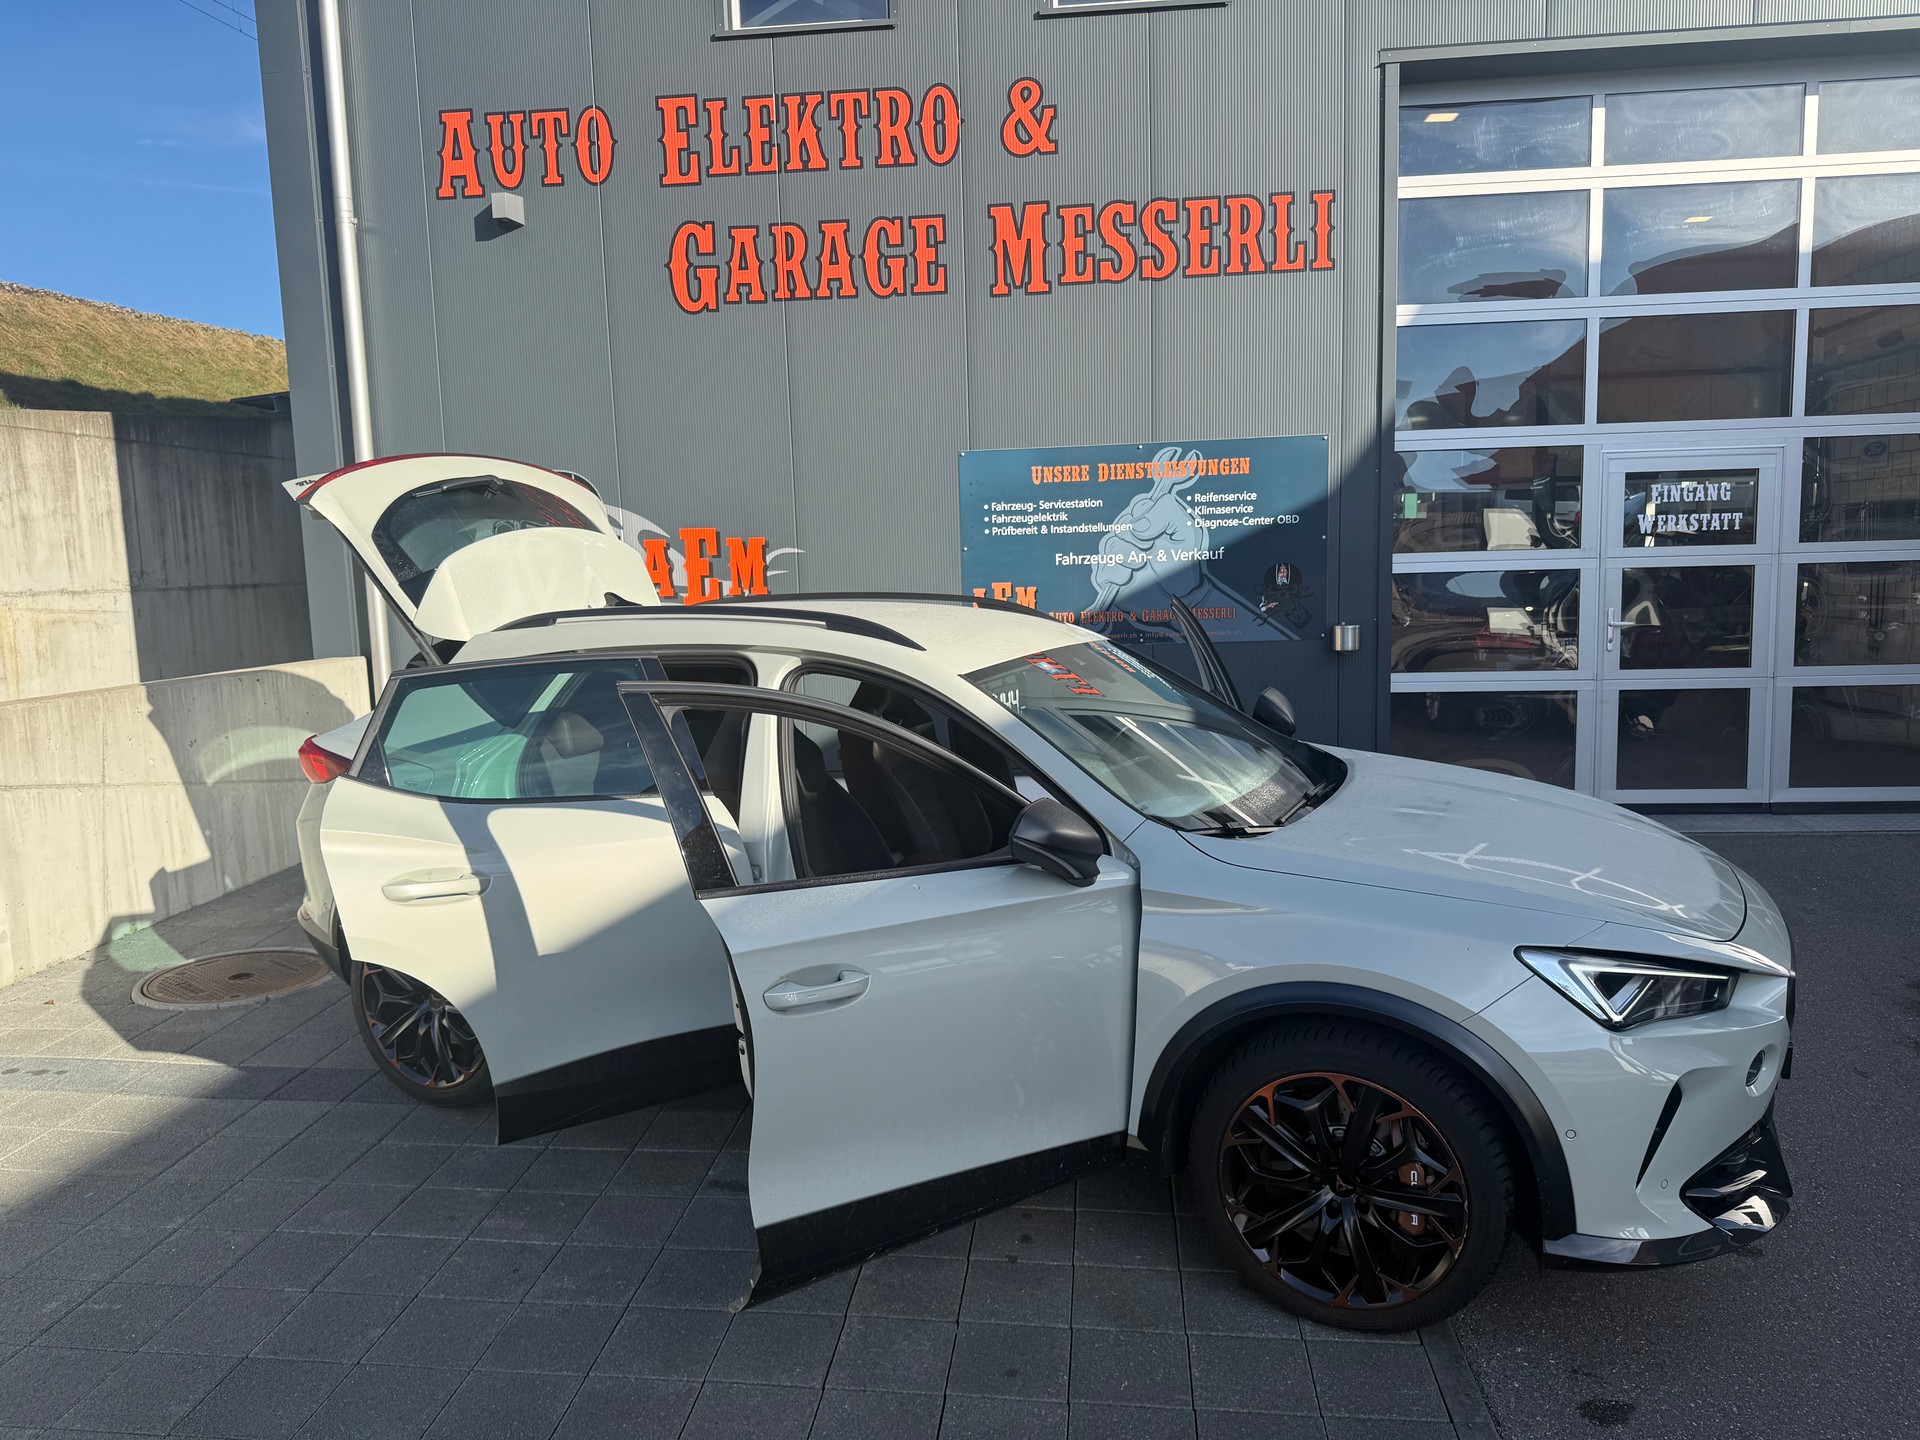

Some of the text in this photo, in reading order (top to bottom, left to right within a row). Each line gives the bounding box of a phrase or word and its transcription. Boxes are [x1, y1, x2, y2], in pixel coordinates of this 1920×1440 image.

[437, 77, 1057, 200] AUTO ELEKTRO &
[667, 191, 1335, 314] GARAGE MESSERLI
[1031, 465, 1090, 485] UNSERE
[1194, 491, 1258, 503] Reifenservice
[1651, 481, 1731, 504] EINGANG
[991, 498, 1103, 513] Fahrzeug- Servicestation
[1194, 503, 1254, 516] Klimaservice
[991, 511, 1068, 524] Fahrzeugelektrik
[1195, 514, 1300, 529] Diagnose-Center OBD
[1637, 512, 1743, 535] WERKSTATT
[992, 521, 1133, 536] Prüfbereit & Instandstellungen
[1054, 546, 1225, 567] Fahrzeuge An- & Verkauf
[1081, 611, 1124, 625] ELEKTRO
[1129, 612, 1137, 621] &
[1141, 609, 1177, 622] GARAG
